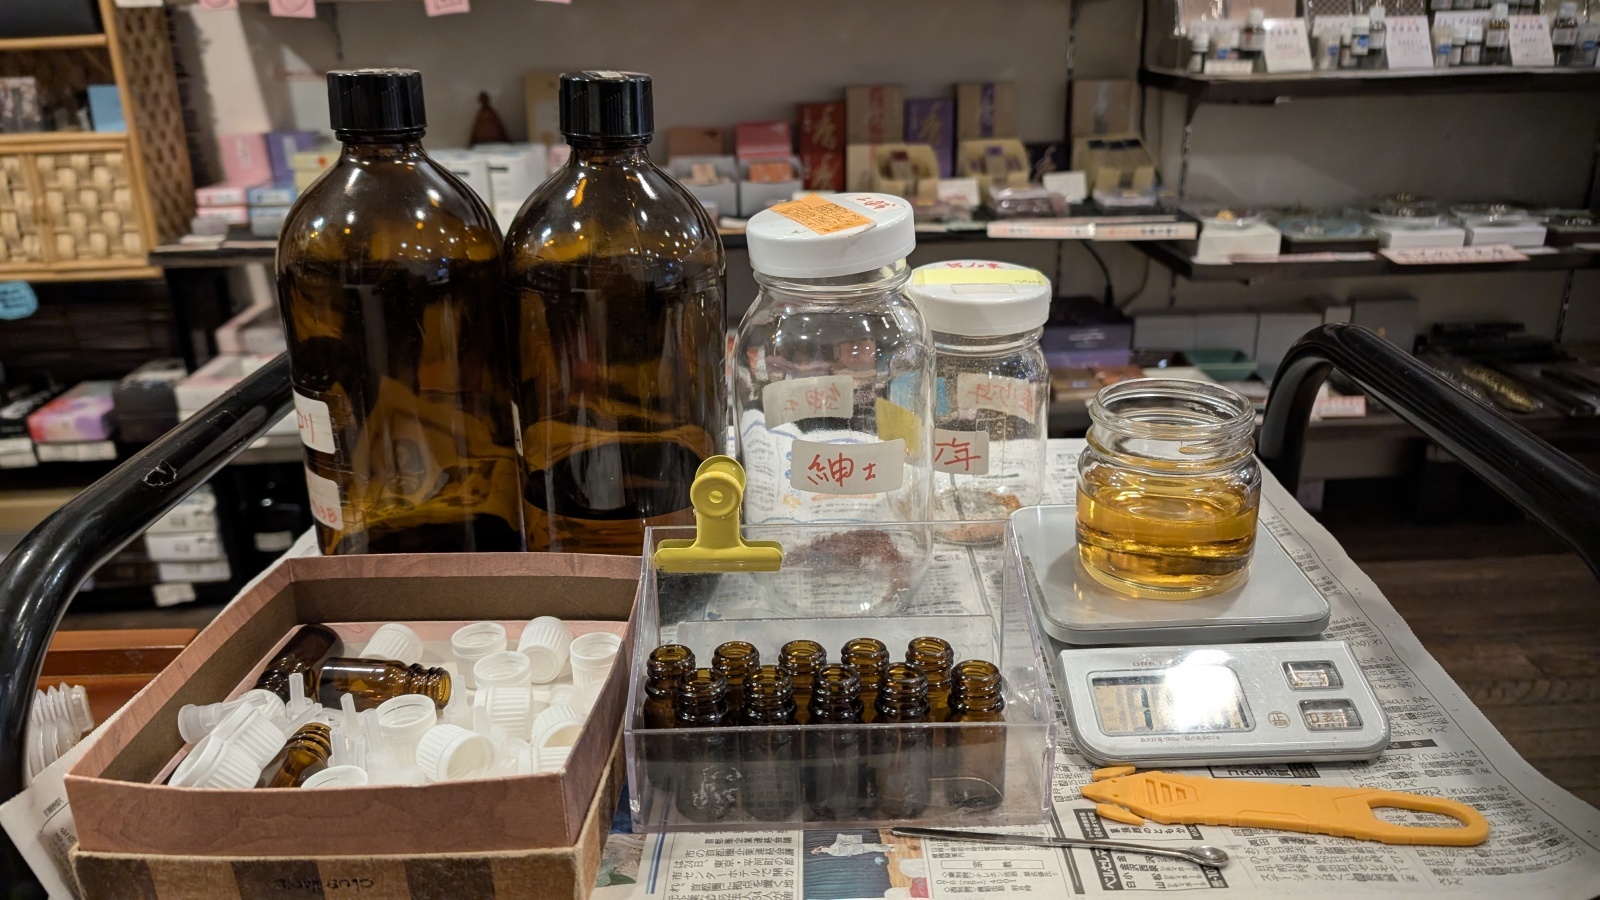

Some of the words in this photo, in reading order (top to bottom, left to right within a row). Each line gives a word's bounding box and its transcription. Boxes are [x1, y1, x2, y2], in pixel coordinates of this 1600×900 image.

[807, 452, 877, 487] 紳士
[685, 847, 795, 858] 市の首都圏企業連絡会議
[671, 867, 795, 880] 市センターホテルで開か
